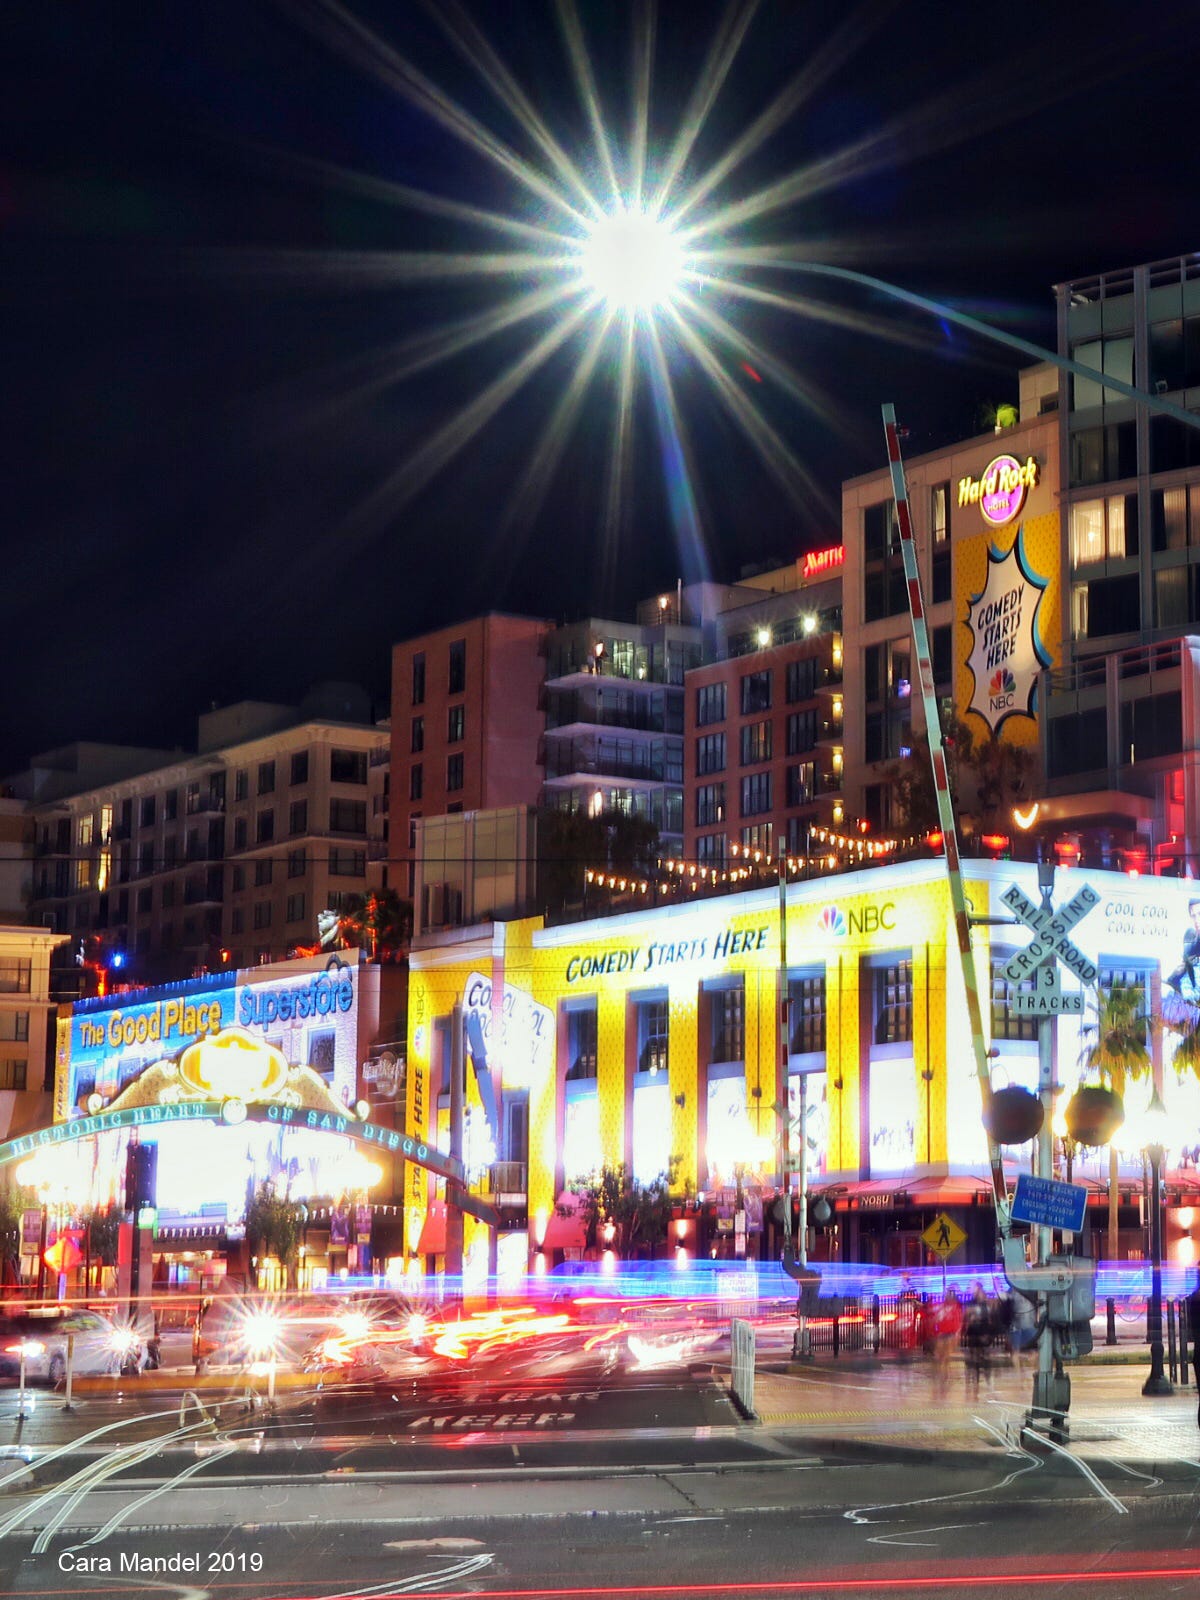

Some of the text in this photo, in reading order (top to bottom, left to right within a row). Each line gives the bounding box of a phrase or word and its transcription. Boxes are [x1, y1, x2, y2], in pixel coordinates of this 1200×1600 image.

[958, 456, 1037, 508] Hard Rock
[988, 498, 1010, 513] HOTEL
[978, 582, 1024, 630] COMEDY
[983, 606, 1022, 651] STARTS
[986, 633, 1017, 671] HERE
[990, 693, 1014, 712] NBC
[848, 902, 897, 936] NBC
[1105, 902, 1134, 917] COOL
[566, 924, 770, 983] COMEDY STARTS HERE
[1004, 886, 1096, 981] RAIL ROAD
[1006, 888, 1096, 981] CROSSING
[1045, 969, 1055, 987] 3
[80, 1020, 105, 1048] The
[107, 1001, 161, 1049] Good
[162, 997, 223, 1038] Place
[239, 972, 354, 1032] Superstore
[415, 984, 425, 1025] NBC
[1017, 996, 1081, 1009] TRACKS
[413, 1067, 424, 1126] HERE
[11, 1102, 428, 1161] HISTORIC HEART OF SAN DIEGO
[407, 1412, 576, 1428] KEEP
